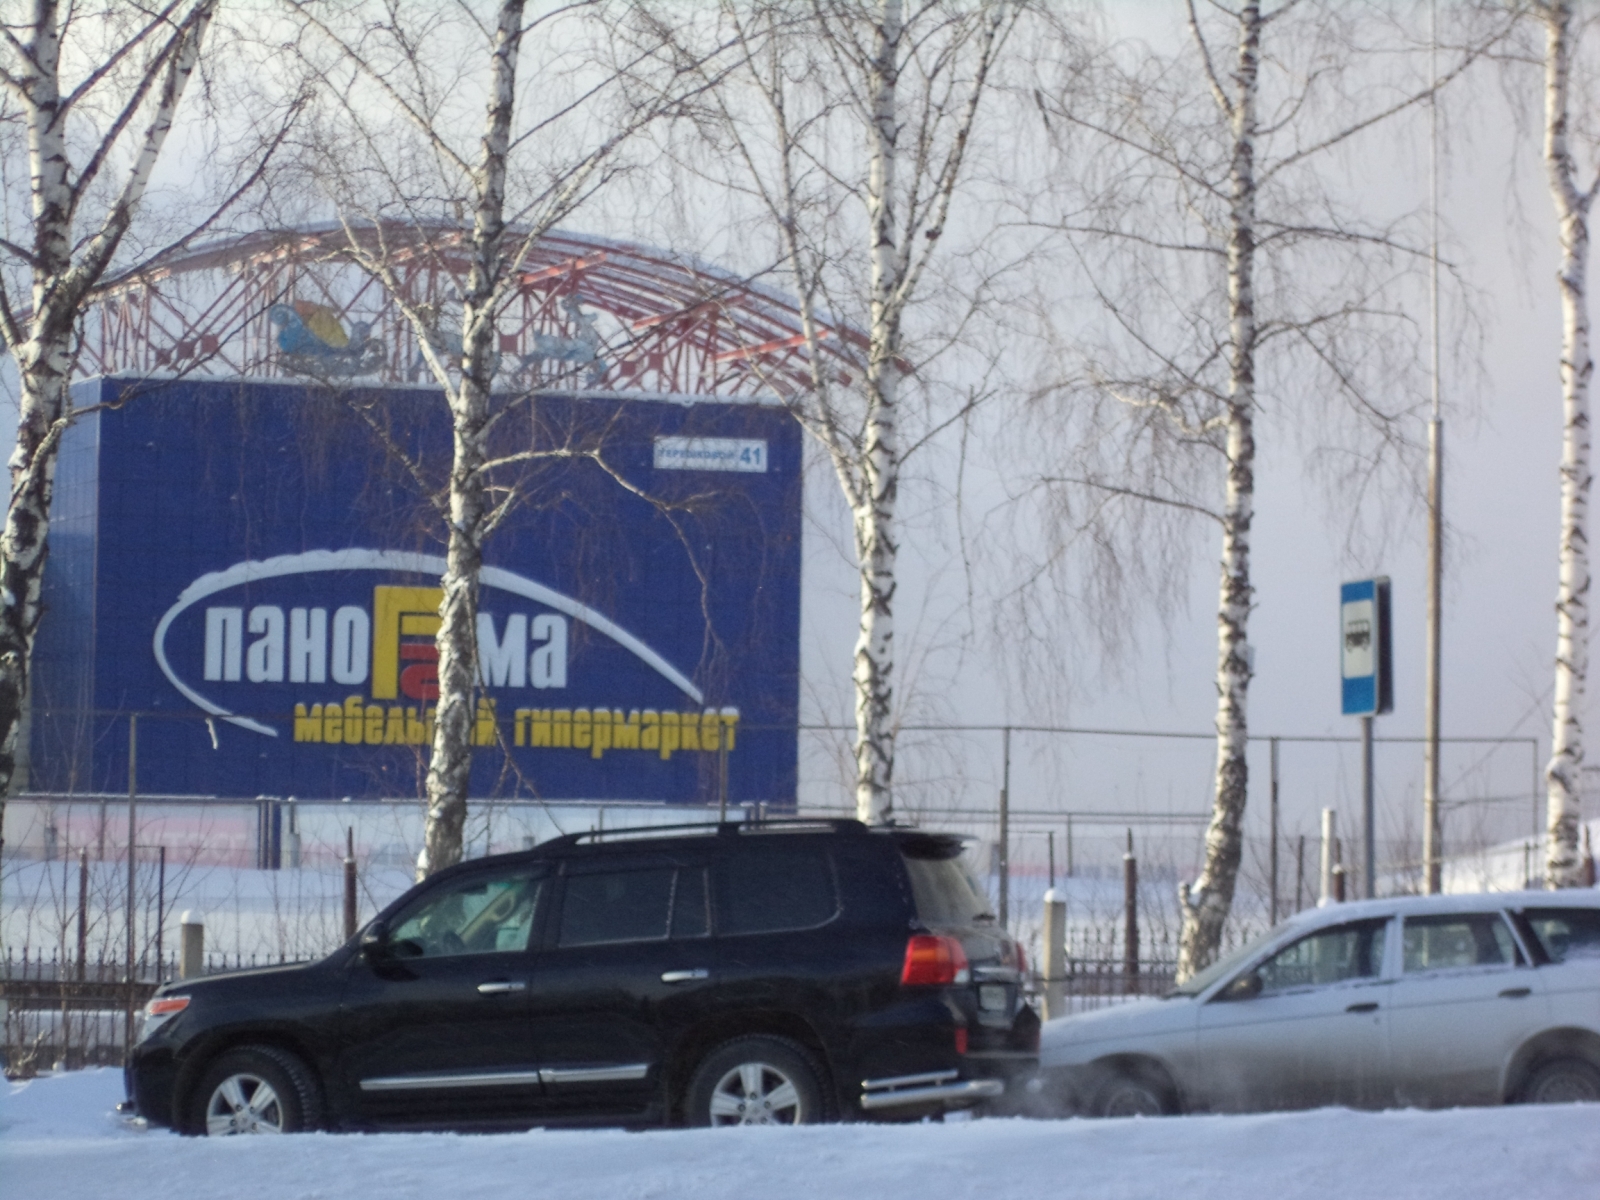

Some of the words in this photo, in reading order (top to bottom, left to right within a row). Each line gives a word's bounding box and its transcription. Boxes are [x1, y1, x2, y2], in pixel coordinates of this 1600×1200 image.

[740, 447, 760, 465] 41
[294, 695, 497, 746] мебельй
[514, 707, 739, 760] гипермаркет
